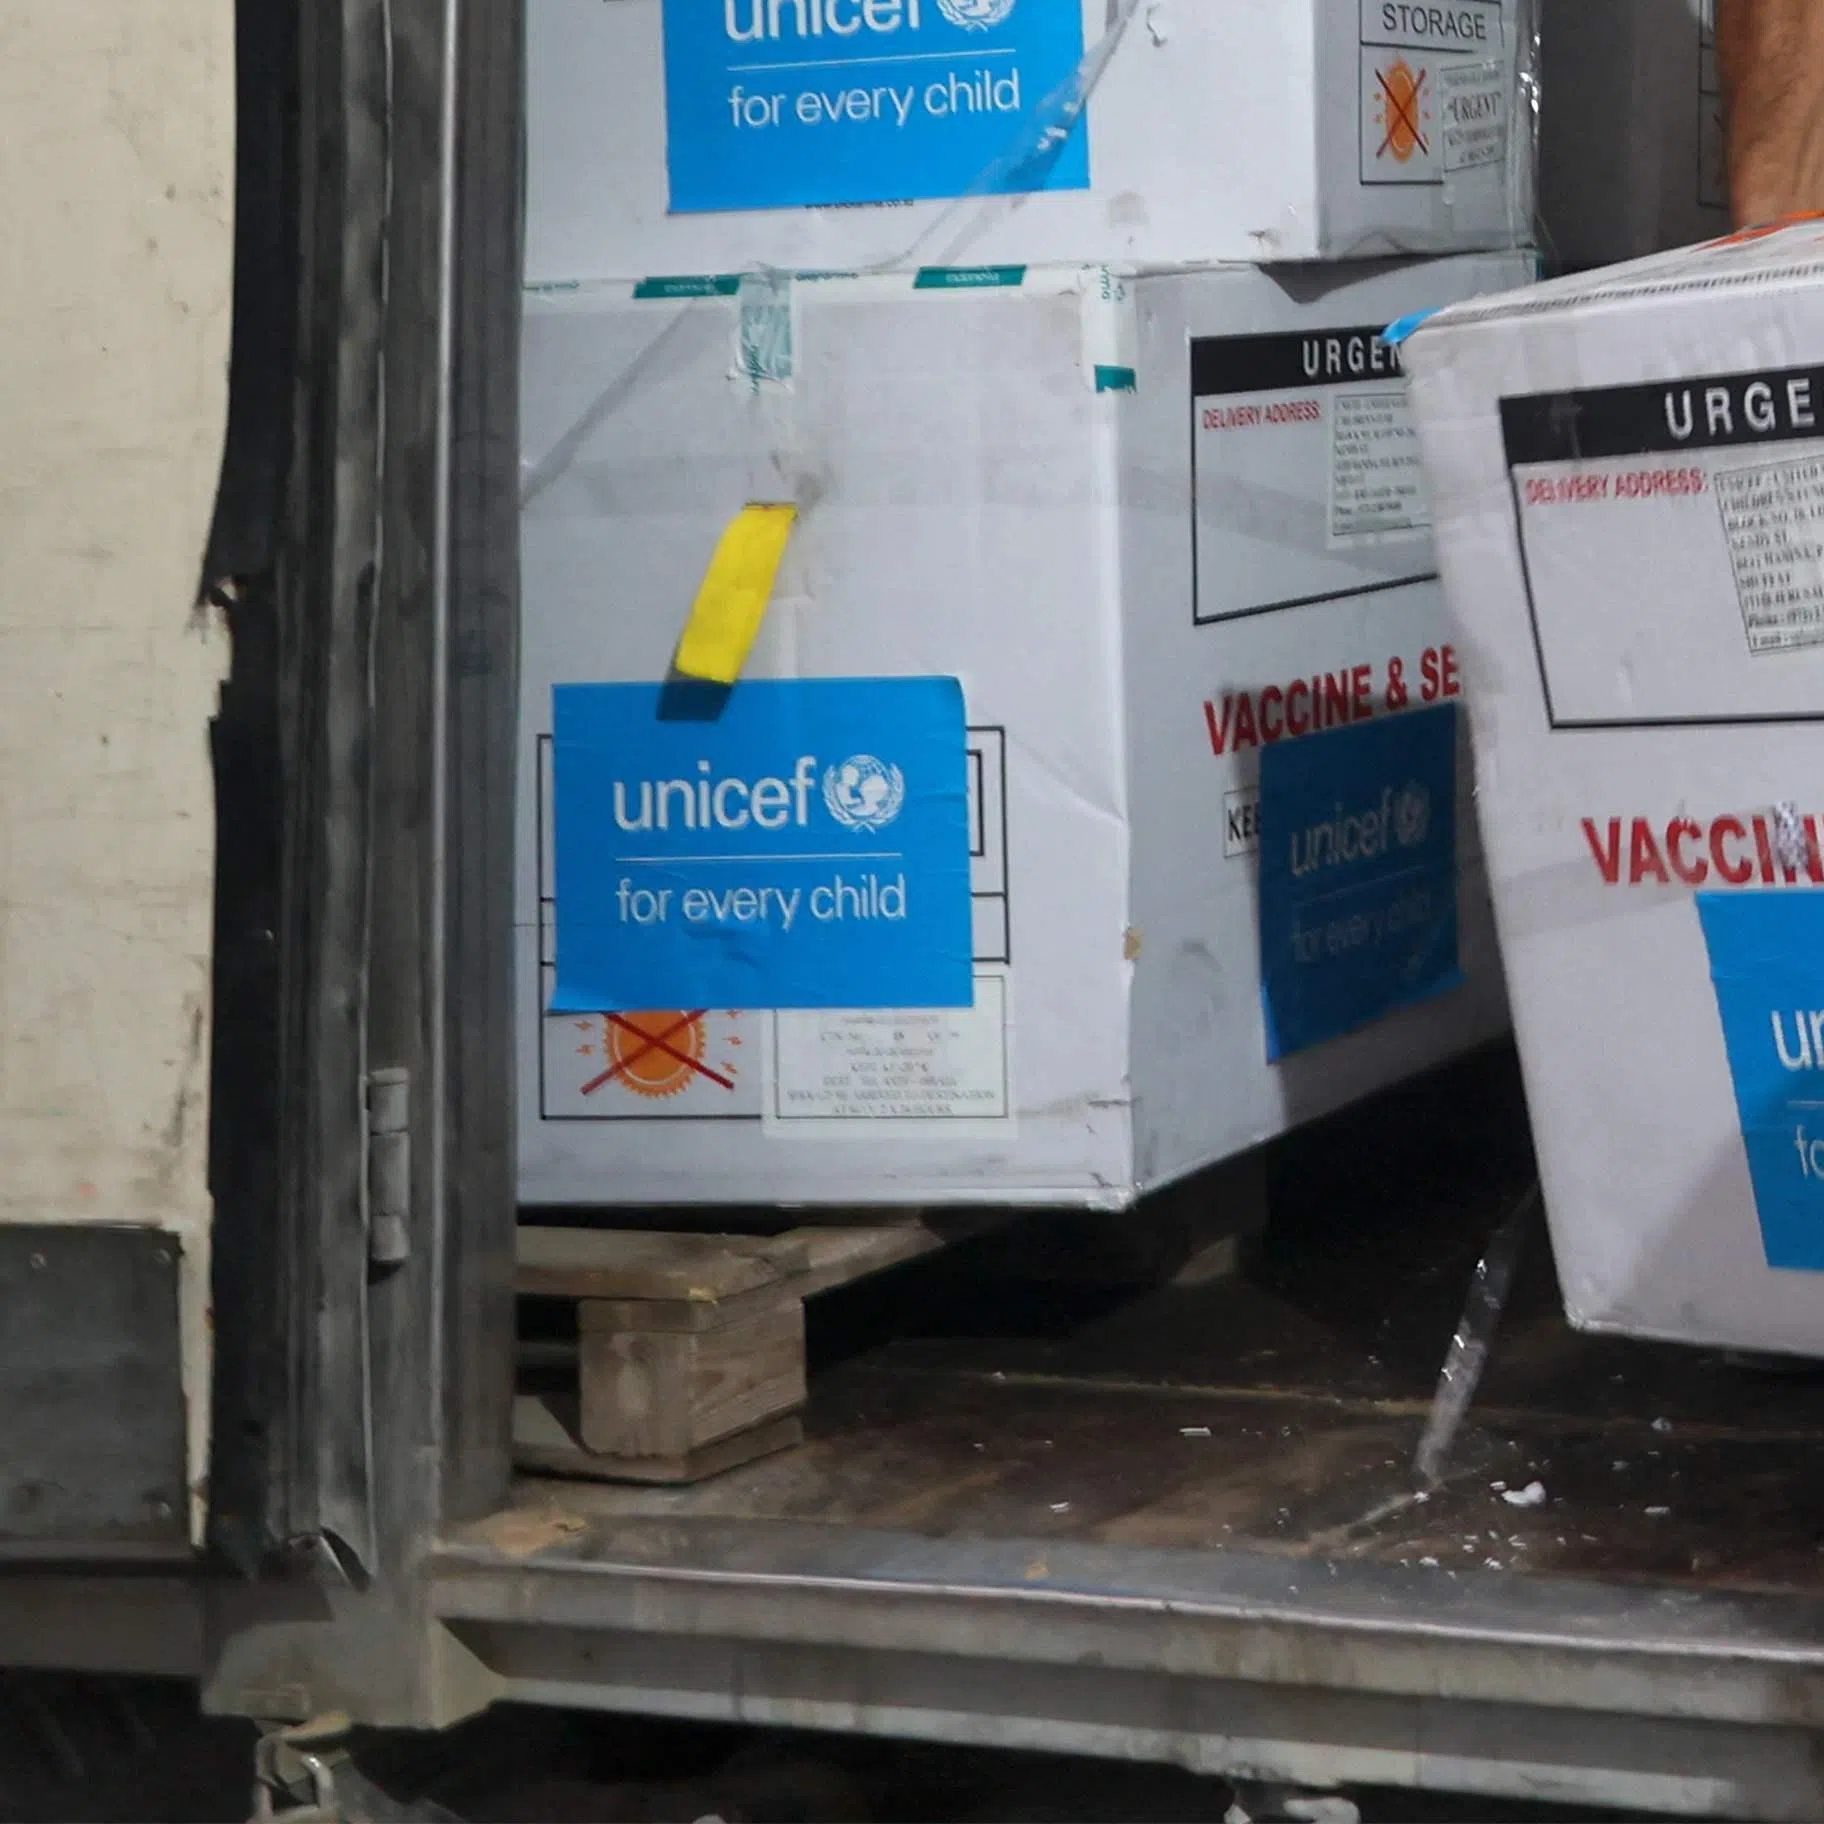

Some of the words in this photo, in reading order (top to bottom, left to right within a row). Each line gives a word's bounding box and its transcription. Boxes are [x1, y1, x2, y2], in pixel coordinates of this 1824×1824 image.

[1382, 2, 1487, 42] STORAGE
[729, 84, 782, 129] for
[795, 82, 914, 127] every
[923, 68, 1021, 118] child
[1525, 474, 1609, 507] DELIVERY
[1203, 664, 1373, 756] VACCINE
[1385, 656, 1408, 712] &
[613, 758, 816, 835] unicef
[1289, 786, 1394, 877] unicef
[615, 878, 671, 925] for
[682, 879, 802, 932] every
[810, 873, 907, 921] child
